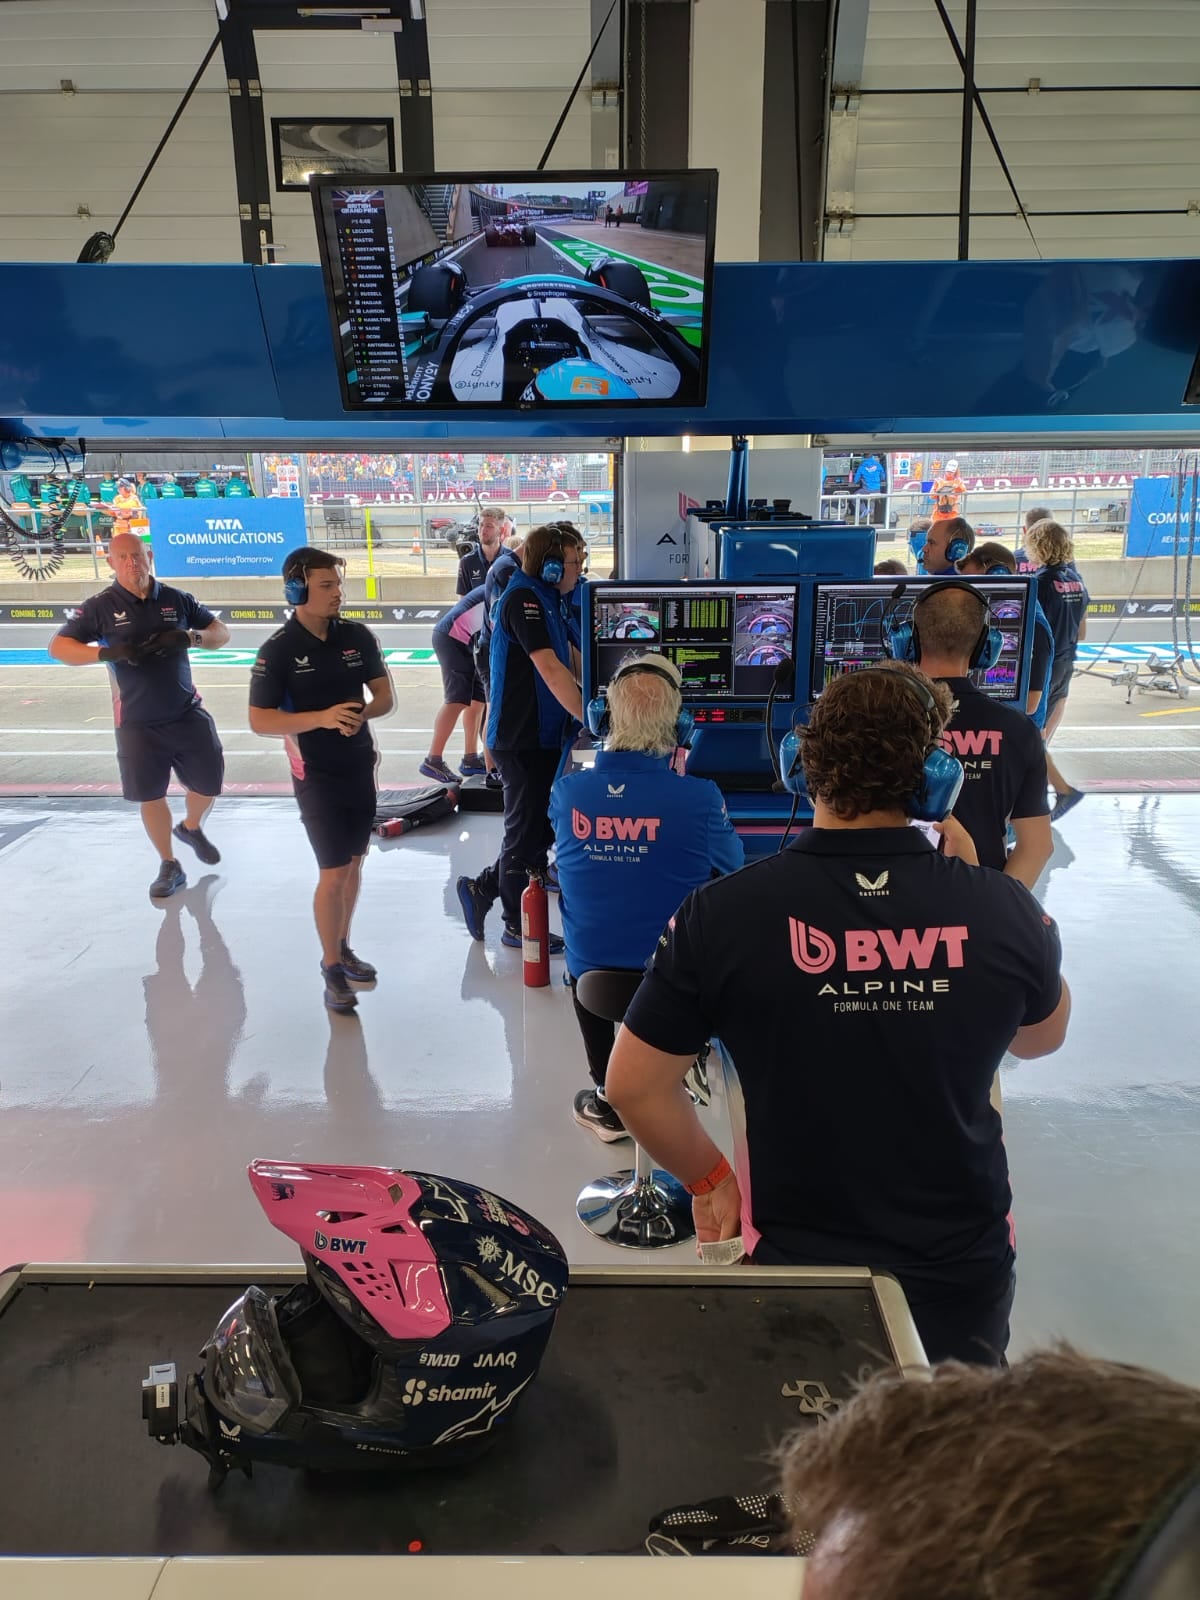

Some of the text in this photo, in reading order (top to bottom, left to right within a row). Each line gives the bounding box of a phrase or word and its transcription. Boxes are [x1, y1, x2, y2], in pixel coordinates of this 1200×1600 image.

[416, 361, 440, 402] ONVOY
[205, 519, 243, 530] TATA
[168, 532, 284, 544] COMMUNICATIONS
[186, 556, 273, 565] #EmpoweringTomorrow
[11, 610, 54, 618] COMING 2026
[230, 610, 274, 618] COMING 2026
[340, 610, 365, 619] COMING
[367, 610, 383, 619] 2026
[596, 816, 660, 841] BWT
[583, 844, 649, 854] ALPINE
[845, 926, 969, 971] BWT
[817, 979, 951, 996] ALPINE
[834, 1000, 934, 1012] FORMULA ONE TEAM
[330, 1238, 367, 1254] BWT
[427, 1382, 496, 1402] shamir
